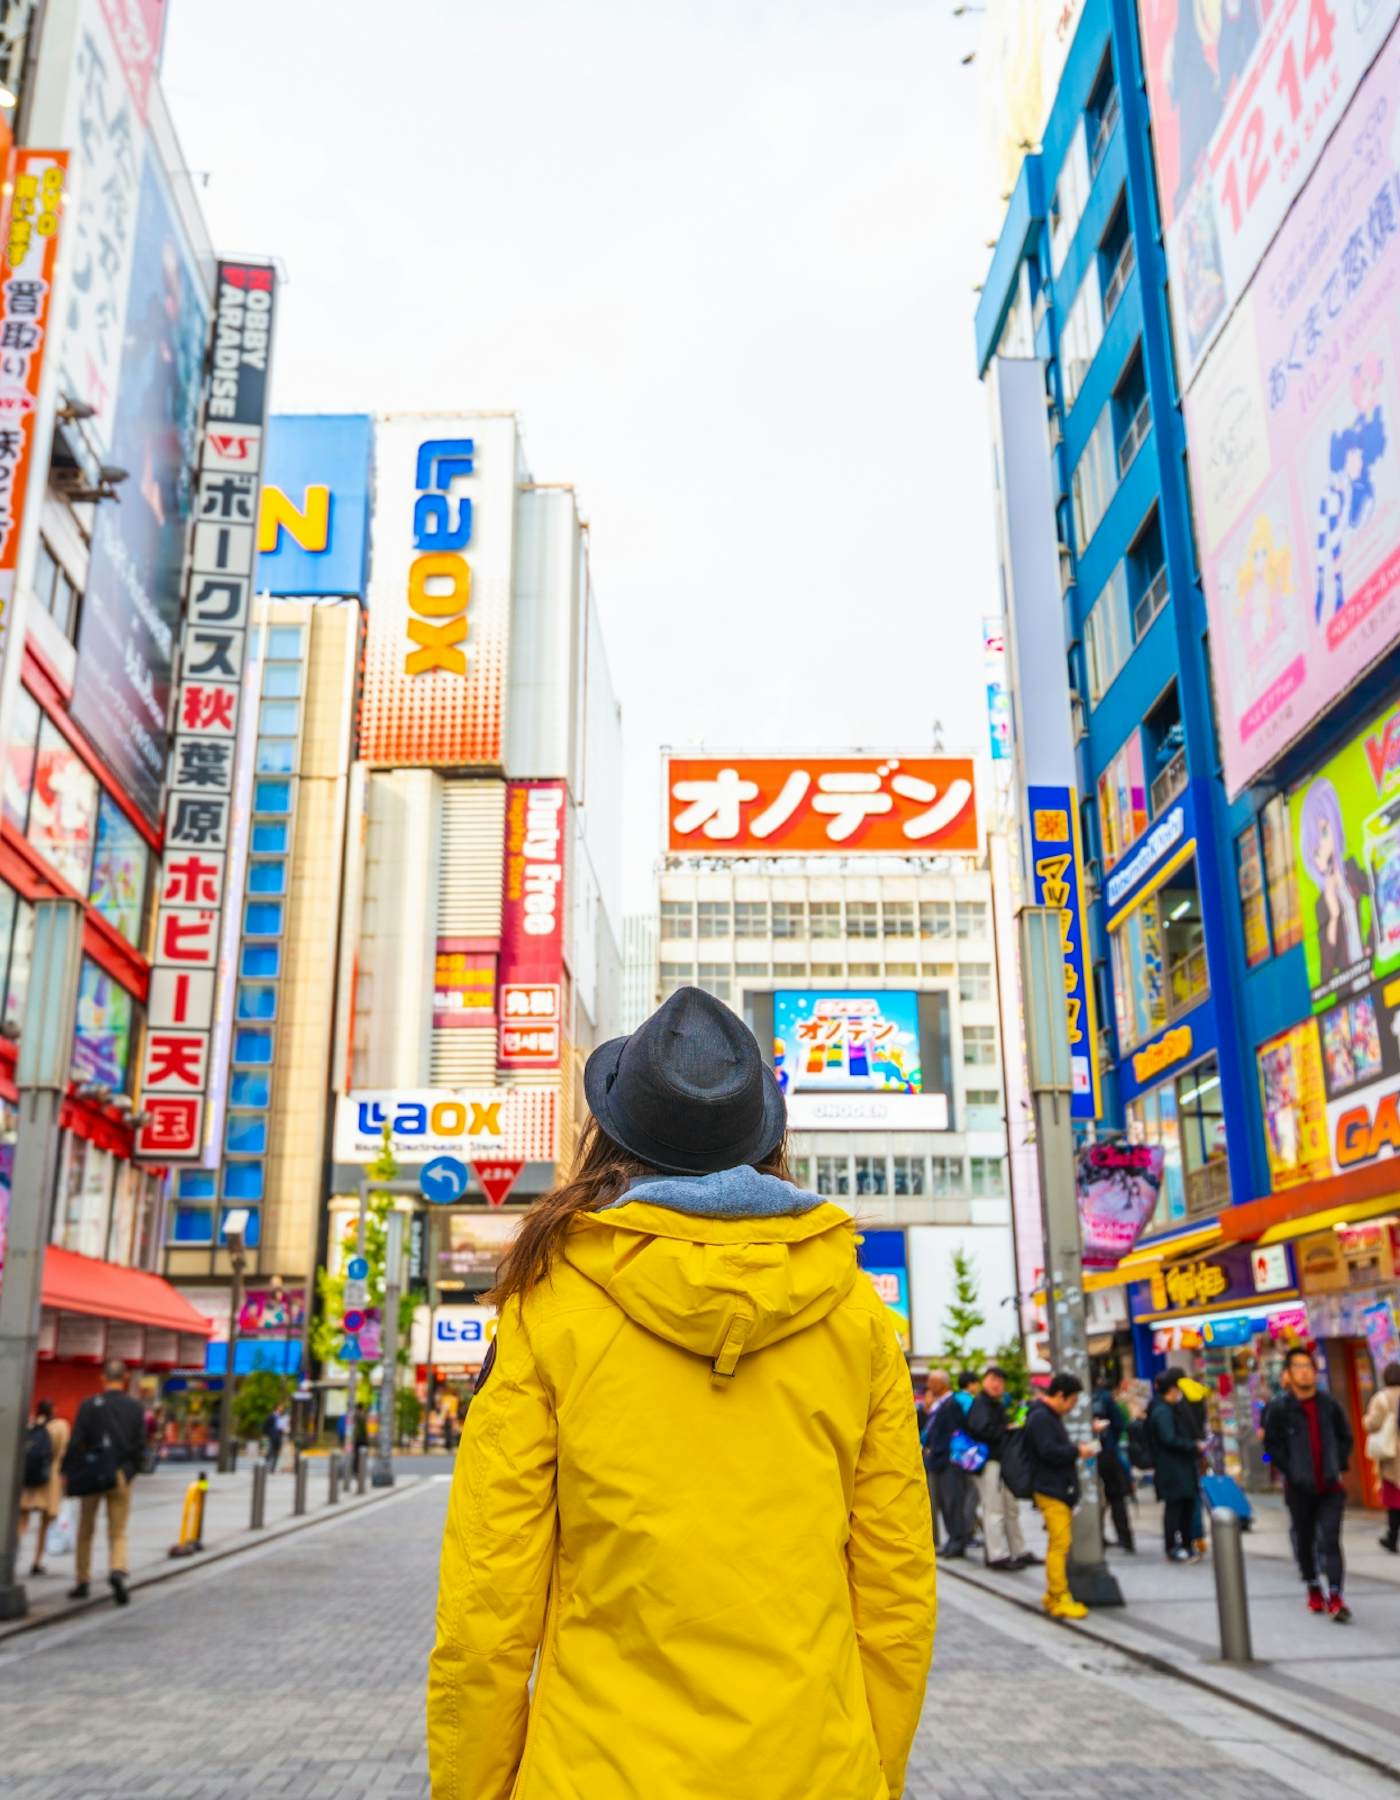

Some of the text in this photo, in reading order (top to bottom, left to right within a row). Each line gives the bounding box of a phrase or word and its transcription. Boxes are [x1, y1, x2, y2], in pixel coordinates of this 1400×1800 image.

[209, 266, 247, 418] PARADISE
[241, 267, 275, 371] HOBBY
[523, 787, 564, 935] Duty Free
[672, 759, 973, 841] オノデン
